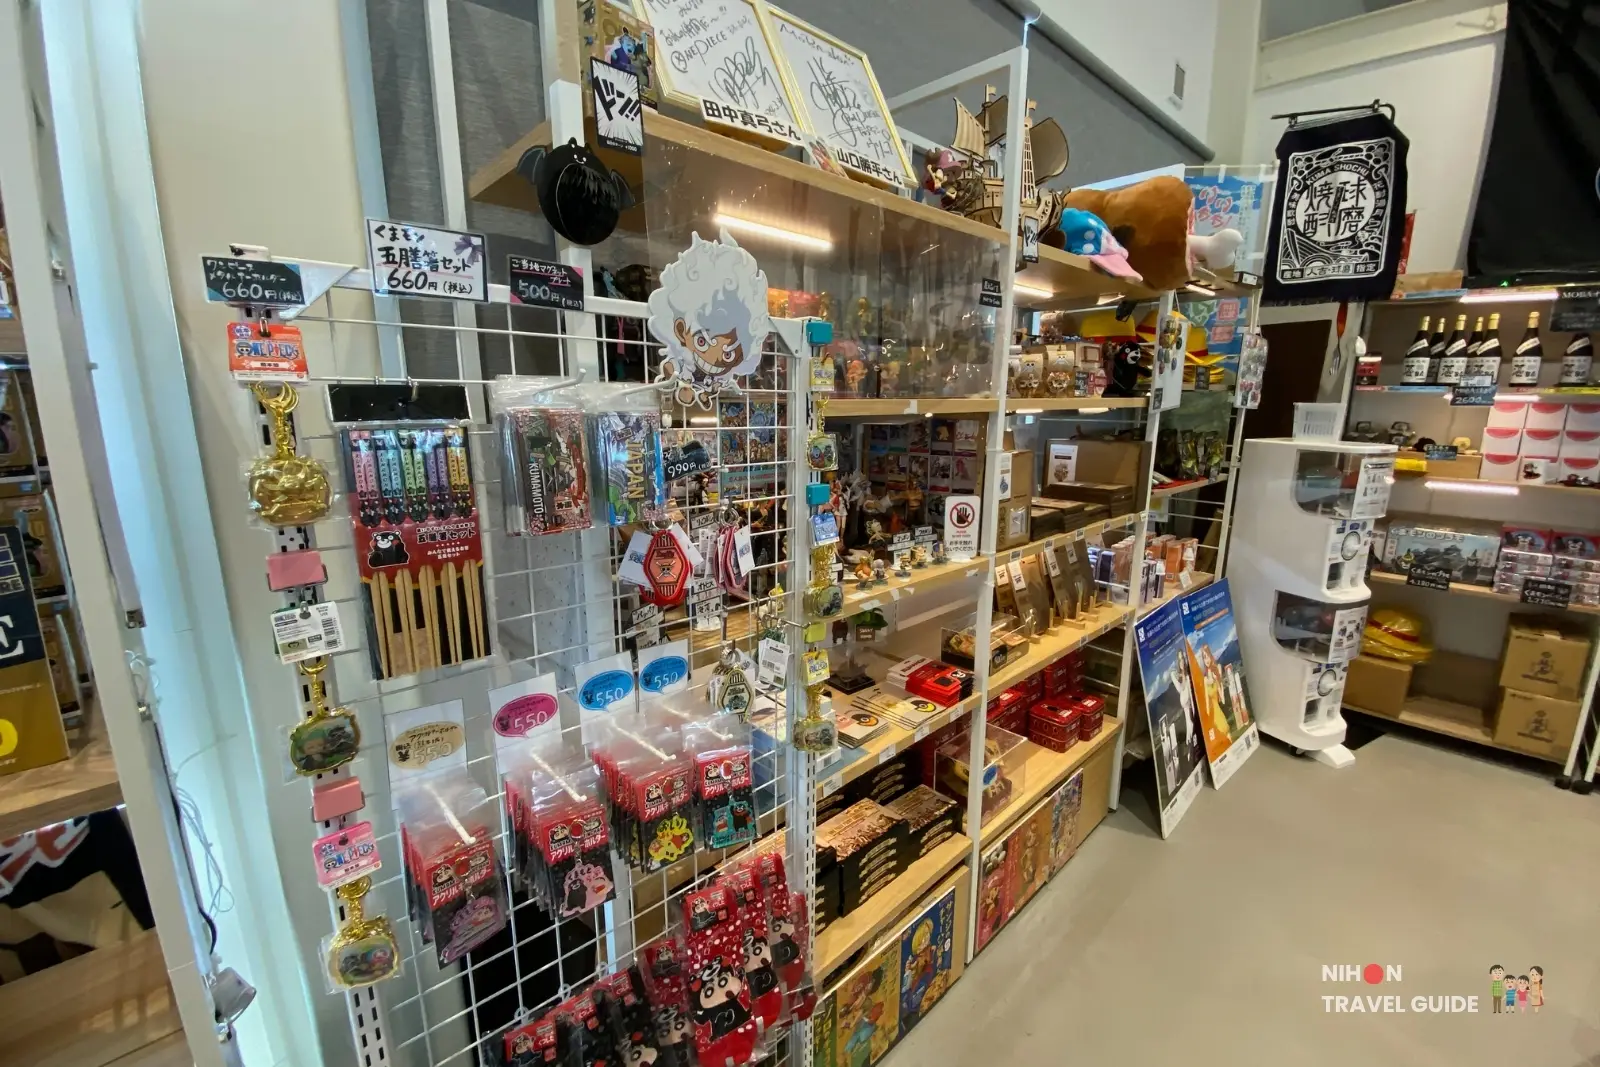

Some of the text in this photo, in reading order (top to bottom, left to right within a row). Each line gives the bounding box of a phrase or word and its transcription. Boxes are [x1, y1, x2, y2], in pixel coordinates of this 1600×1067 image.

[702, 99, 801, 141] 田中真弓さん
[374, 225, 425, 242] くまモン
[625, 439, 645, 499] JAPAN
[528, 462, 544, 514] KUMAMOTO
[654, 671, 678, 689] 550
[596, 687, 624, 707] 550
[514, 710, 548, 733] 550
